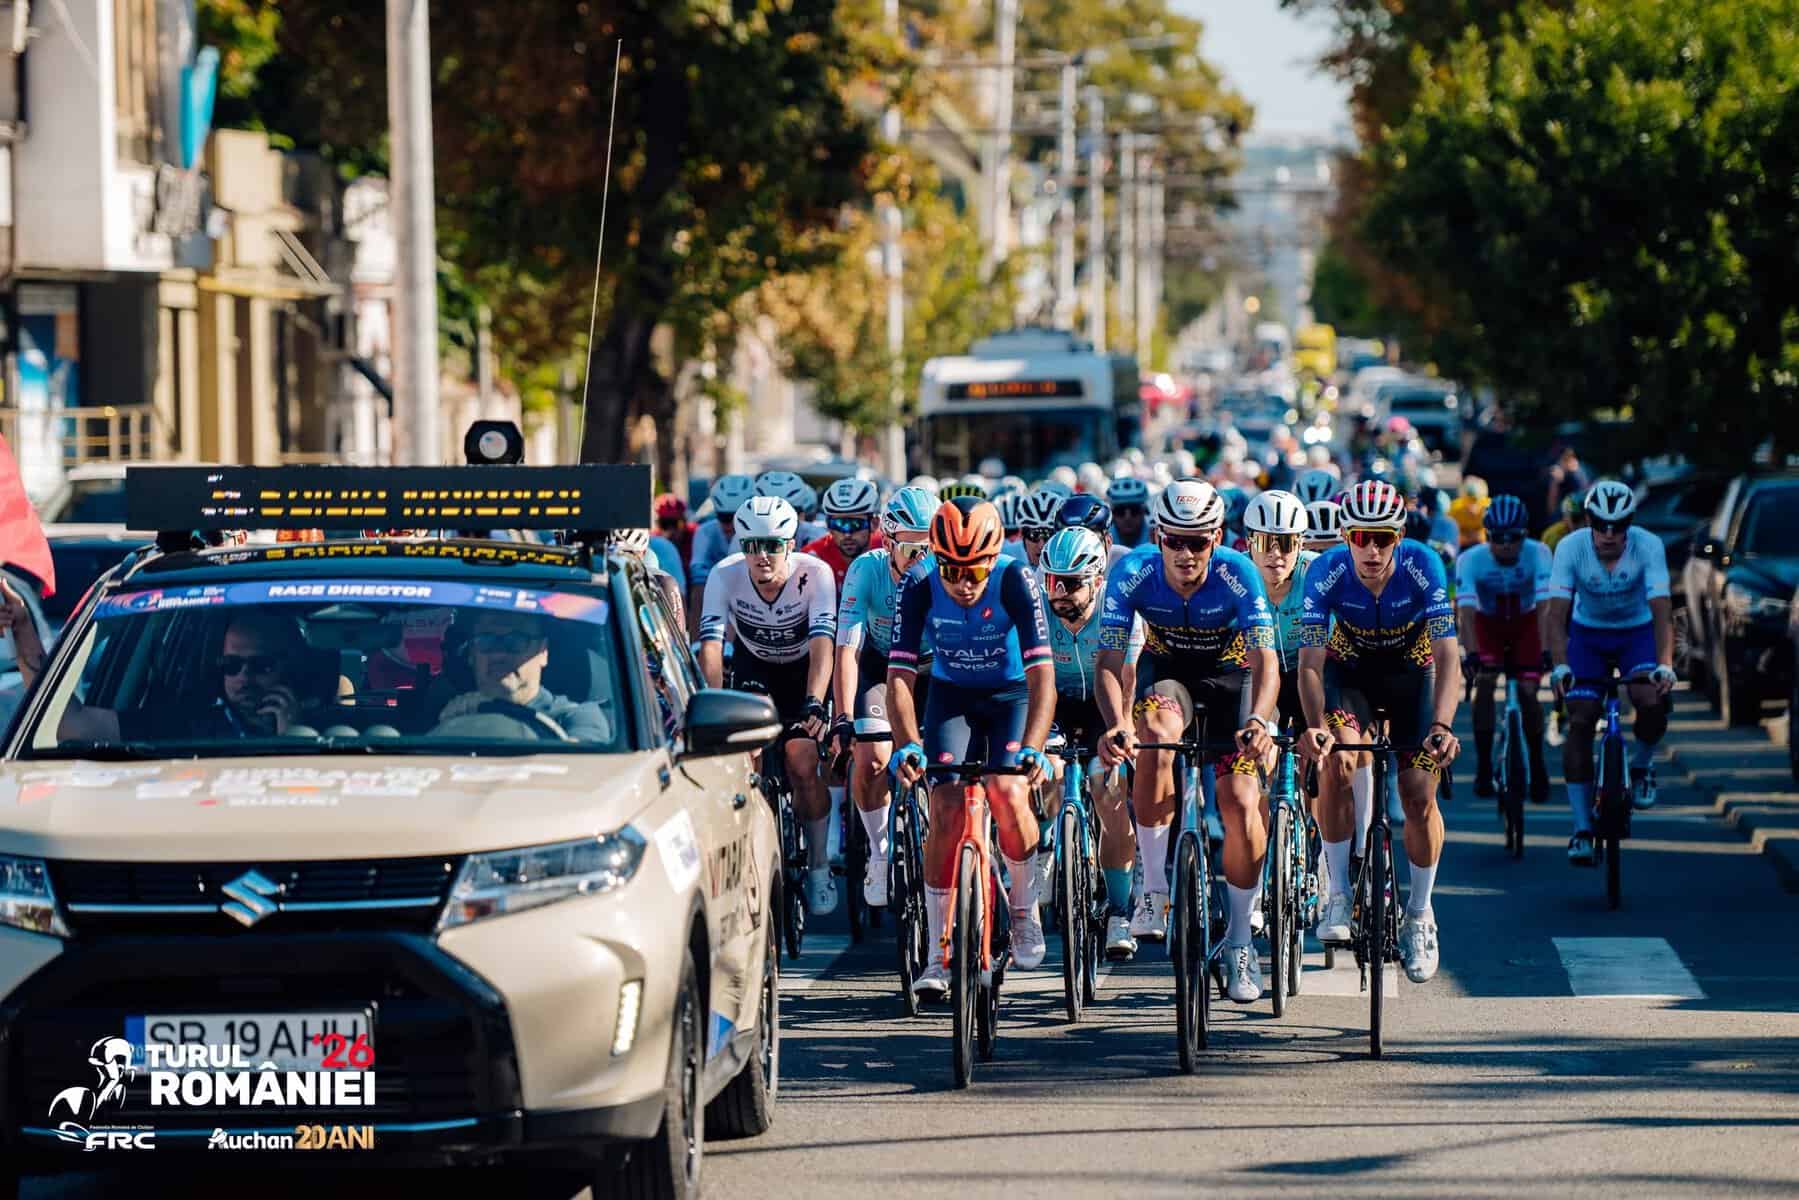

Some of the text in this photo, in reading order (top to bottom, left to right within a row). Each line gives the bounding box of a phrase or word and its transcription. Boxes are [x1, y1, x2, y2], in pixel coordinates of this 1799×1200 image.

[1118, 563, 1155, 598] Auchan
[1215, 563, 1248, 598] Auchan
[1315, 562, 1347, 596] Auchan
[1403, 556, 1429, 590] Auchan
[268, 585, 432, 598] RACE DIRECTOR
[1021, 567, 1047, 640] CASTELLI
[754, 629, 796, 641] APS
[936, 646, 1006, 658] ITALIA
[225, 1020, 260, 1056] 19
[268, 1020, 358, 1057] AHH
